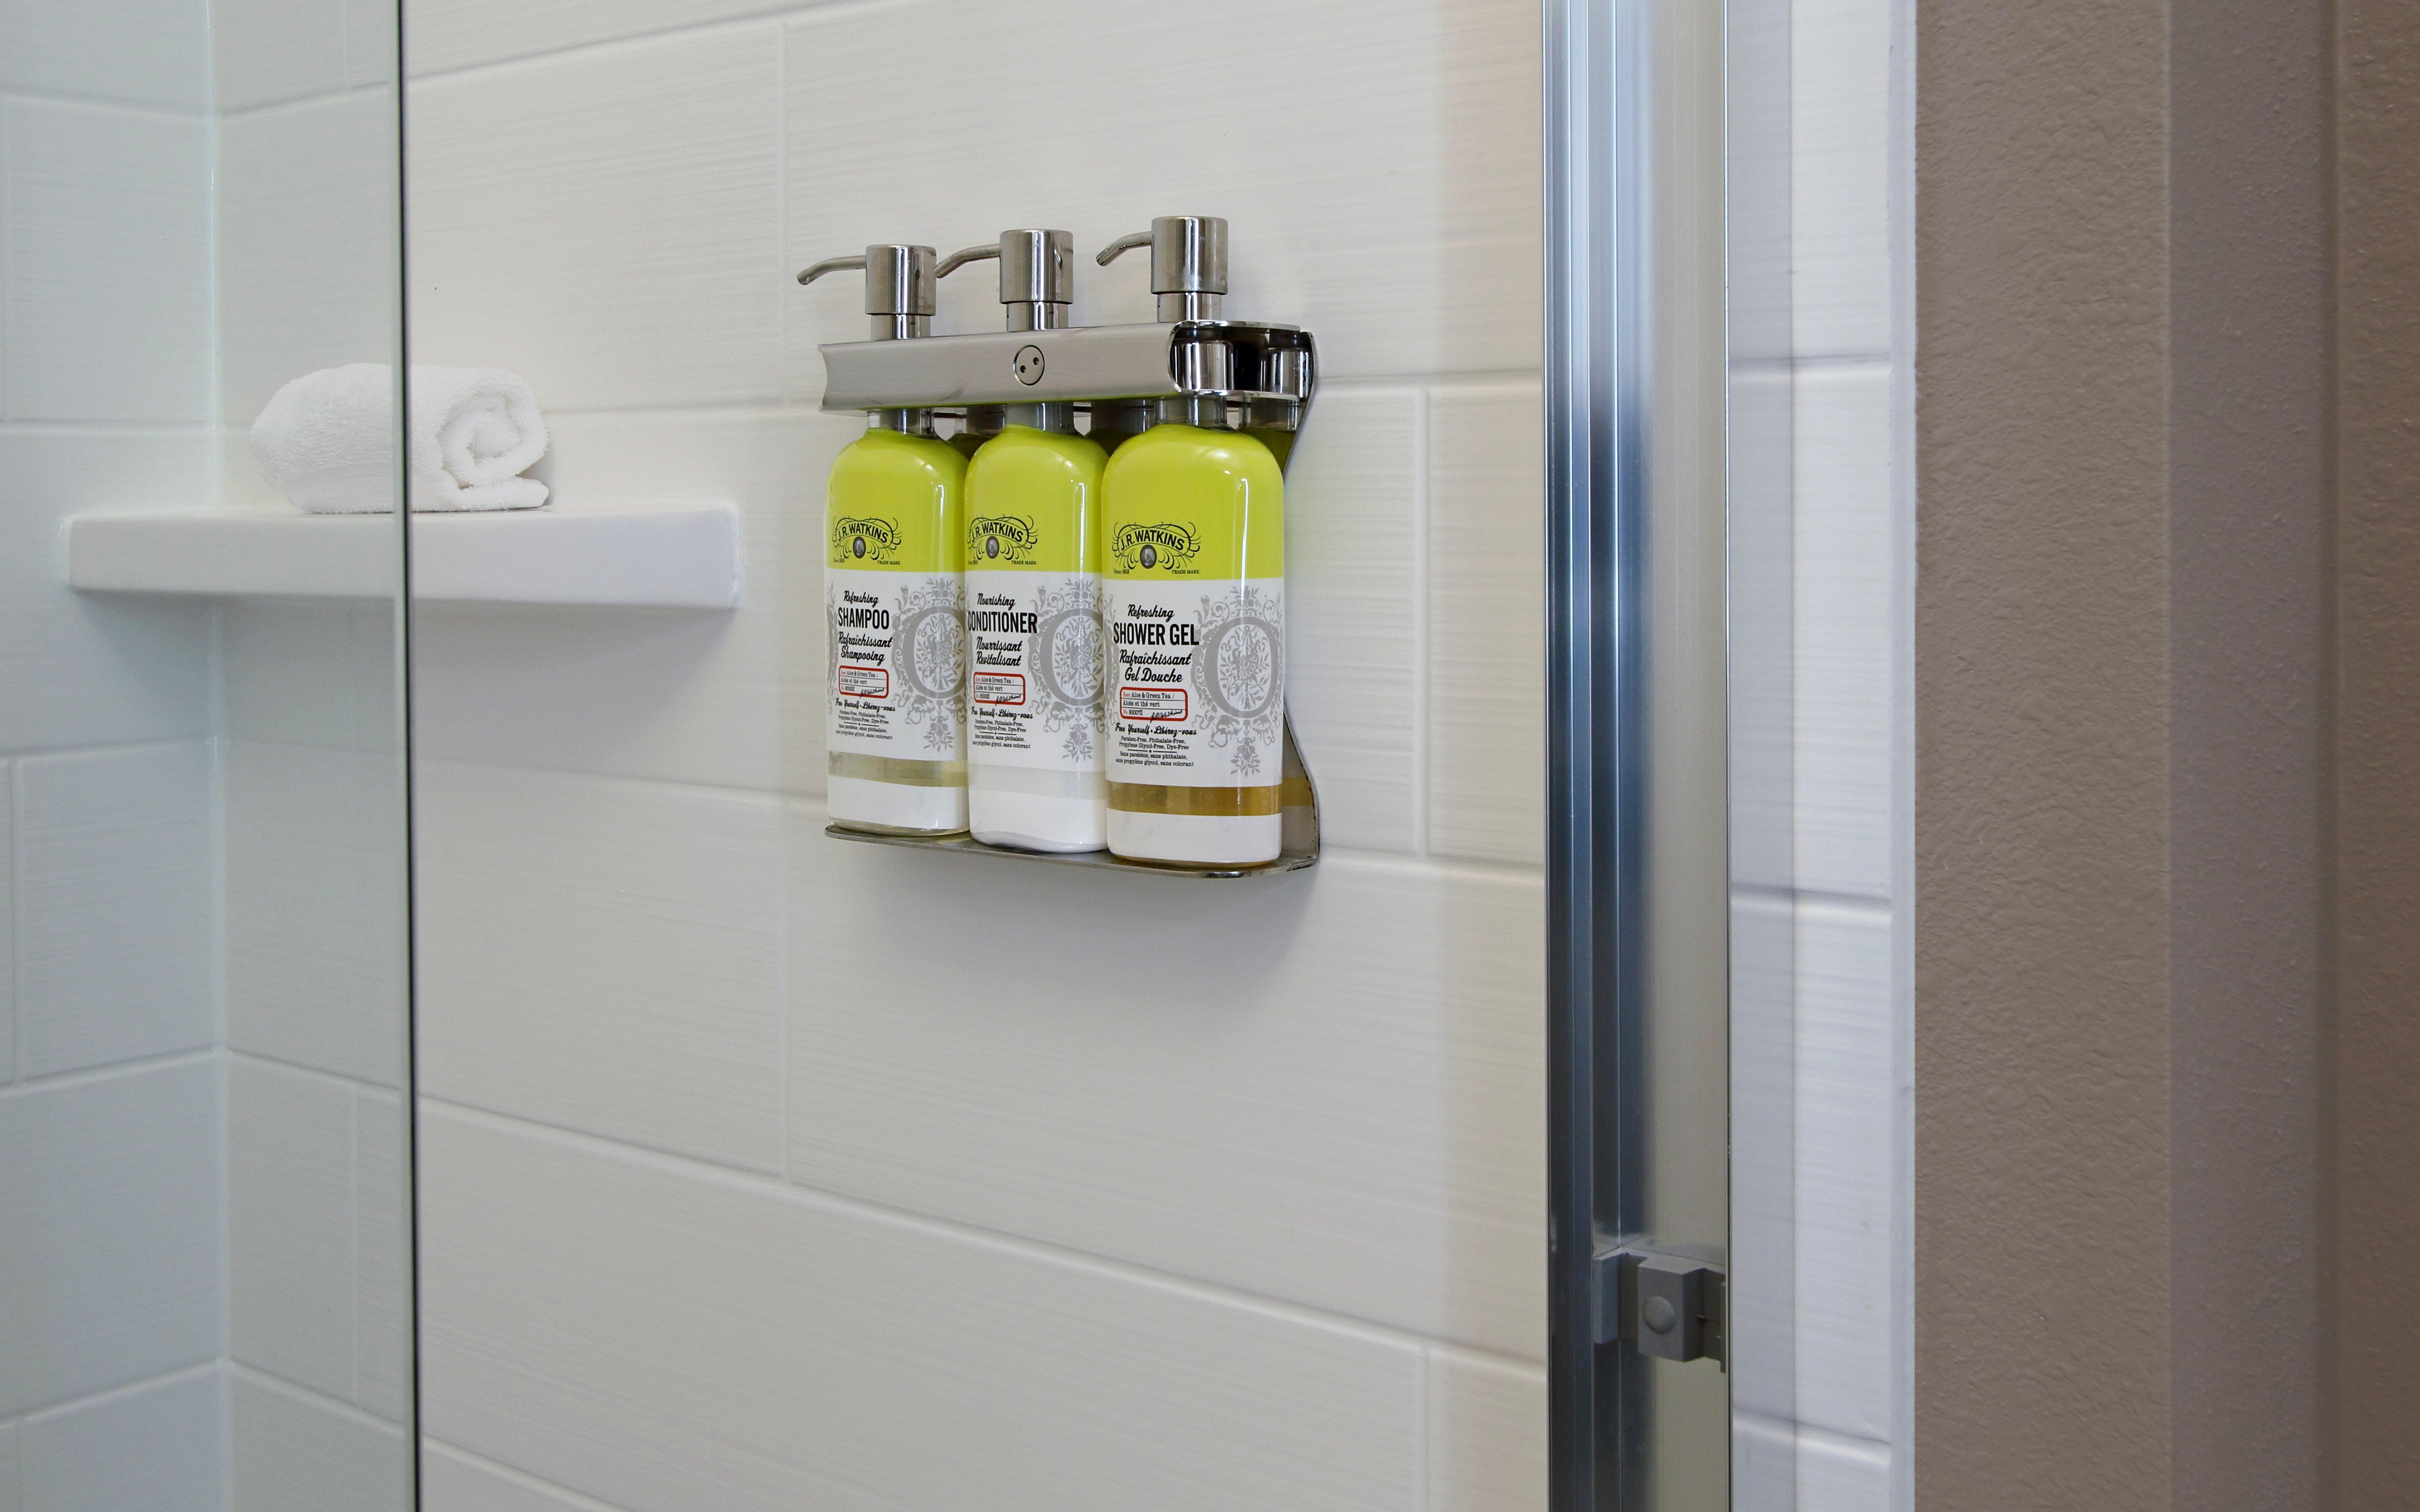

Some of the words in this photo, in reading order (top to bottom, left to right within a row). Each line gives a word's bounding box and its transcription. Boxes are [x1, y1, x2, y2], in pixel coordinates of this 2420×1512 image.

[838, 526, 849, 541] J.R.
[849, 523, 889, 543] WATKINS
[972, 526, 982, 542] J.R.
[981, 522, 1023, 542] WATKINS
[1121, 534, 1135, 550] J.R.
[1134, 529, 1185, 550] WATKINS
[844, 590, 878, 608] Refreshing
[978, 593, 1016, 610] Nourishing
[838, 607, 889, 630] SHAMPOO
[1128, 604, 1175, 622] Refreshing
[968, 611, 1037, 634] CONDITIONER
[838, 631, 892, 648] Rafraîchissant
[1113, 622, 1165, 645] SHOWER
[1169, 624, 1200, 645] GEL
[977, 636, 1023, 651] Nourrissant
[841, 646, 885, 666] Shampooing
[977, 651, 1022, 666] Revitalisant
[1119, 649, 1192, 666] Rafraîchissant
[1125, 667, 1141, 681] Gel
[1141, 667, 1183, 683] Douche
[1115, 722, 1125, 732] Free
[1128, 724, 1150, 735] Yourself
[1153, 725, 1197, 738] Libérez-vous
